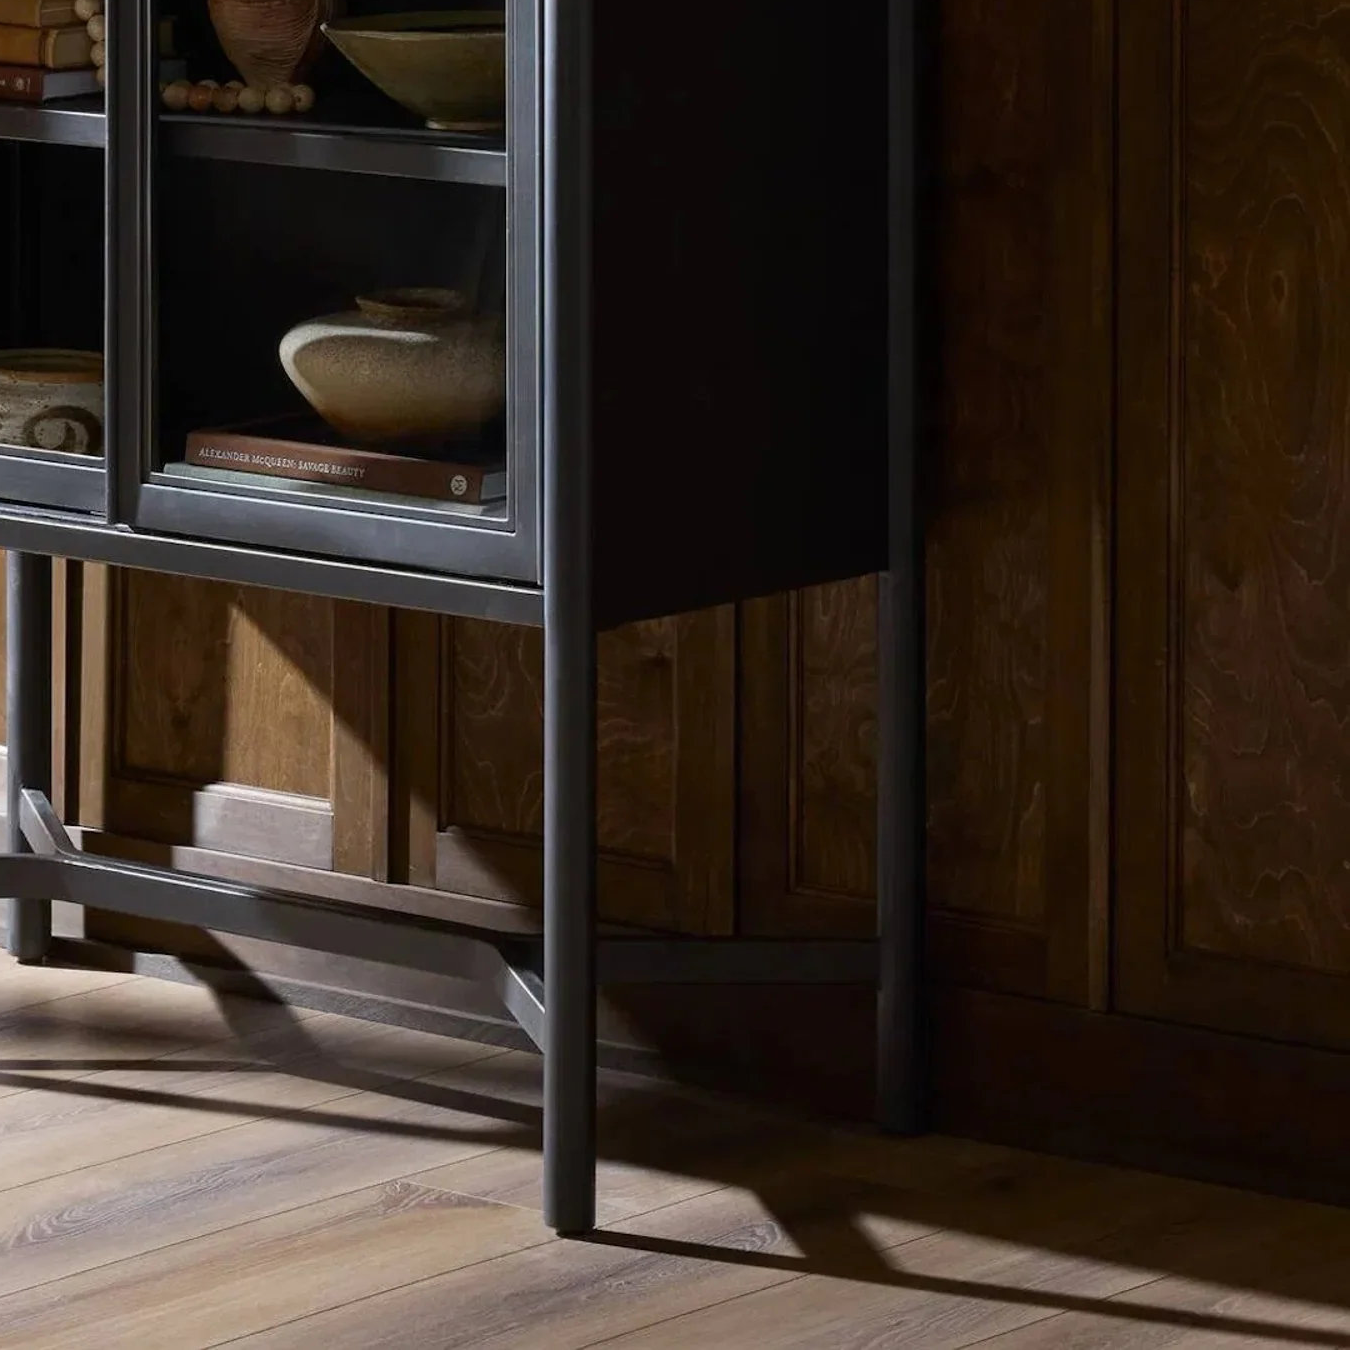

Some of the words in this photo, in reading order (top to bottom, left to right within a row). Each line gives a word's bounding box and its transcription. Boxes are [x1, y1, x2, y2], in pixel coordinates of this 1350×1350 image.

[199, 447, 250, 462] ALEXANDER
[298, 460, 330, 474] SAVAGE
[331, 464, 366, 479] BEAUTY
